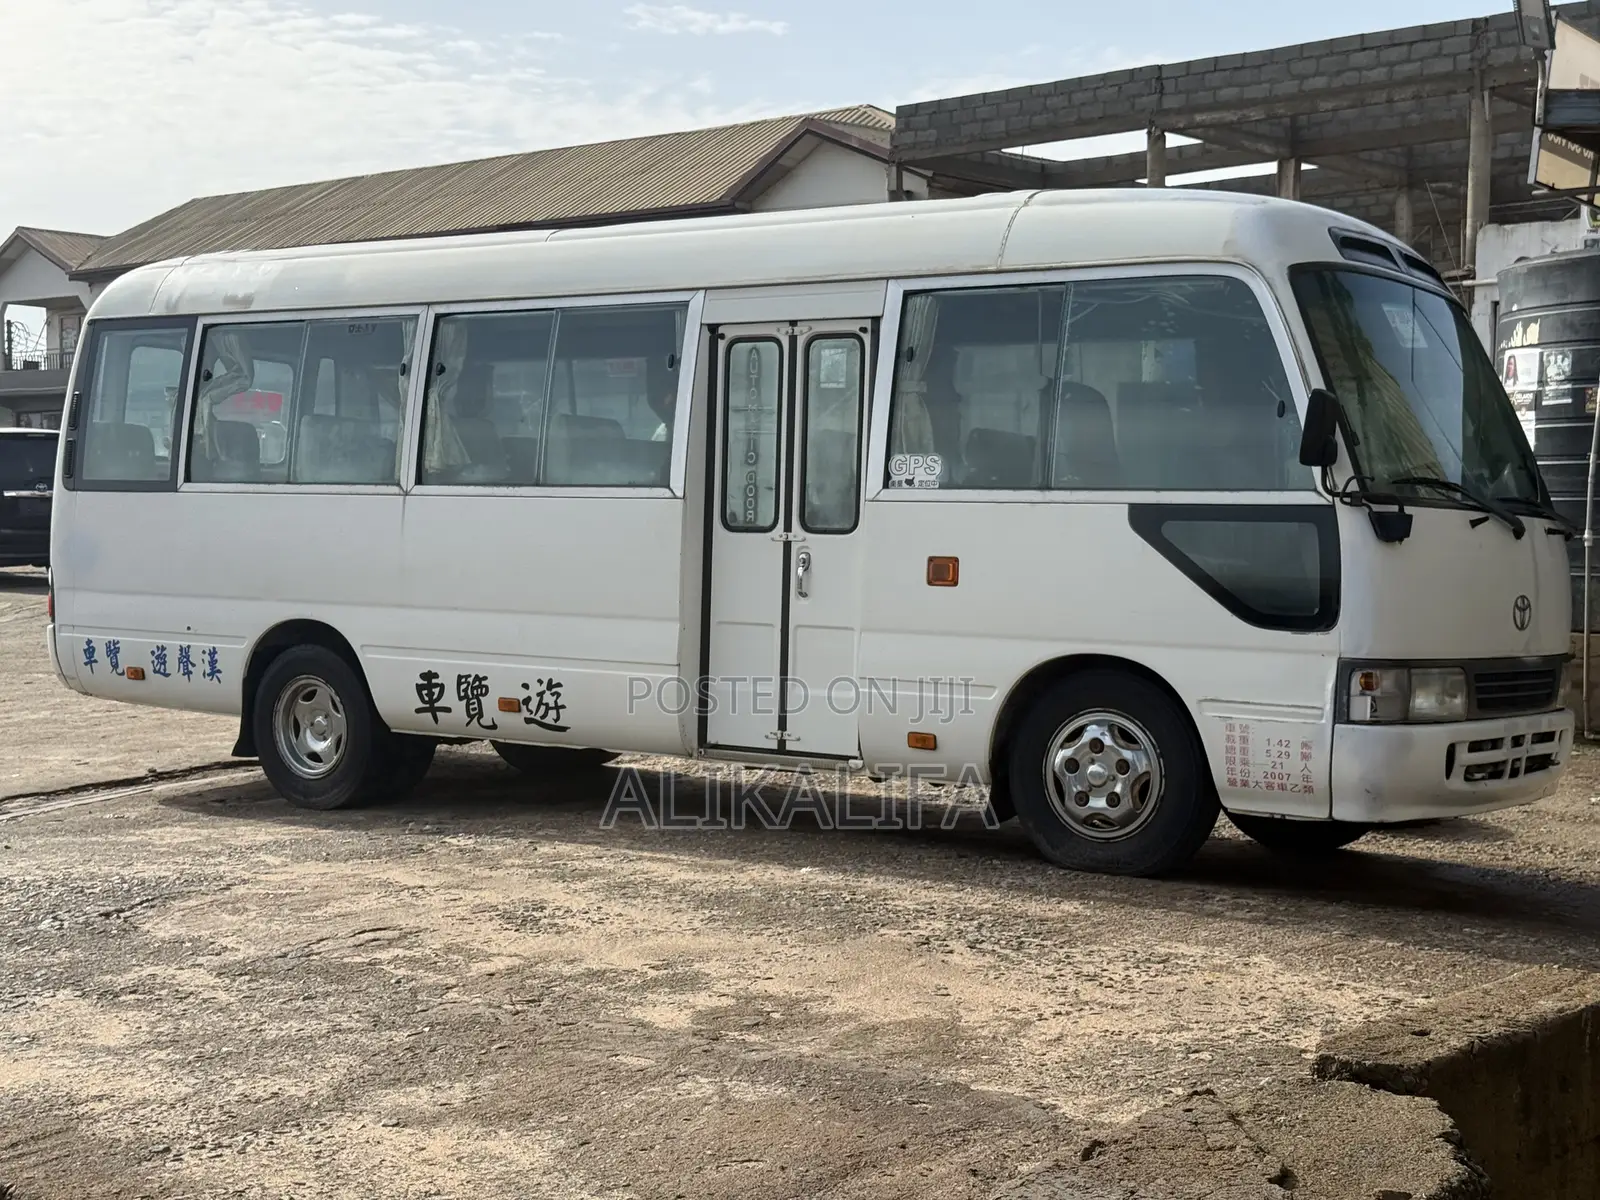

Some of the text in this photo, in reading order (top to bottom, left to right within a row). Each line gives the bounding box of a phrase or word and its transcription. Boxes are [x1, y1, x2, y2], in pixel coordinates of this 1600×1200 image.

[890, 455, 942, 476] GPS
[1265, 738, 1291, 748] 1.42
[1265, 749, 1291, 759] 5.29
[1271, 761, 1284, 770] 21
[1300, 763, 1313, 773] 人
[1263, 771, 1291, 781] 2007
[1300, 774, 1313, 783] 年
